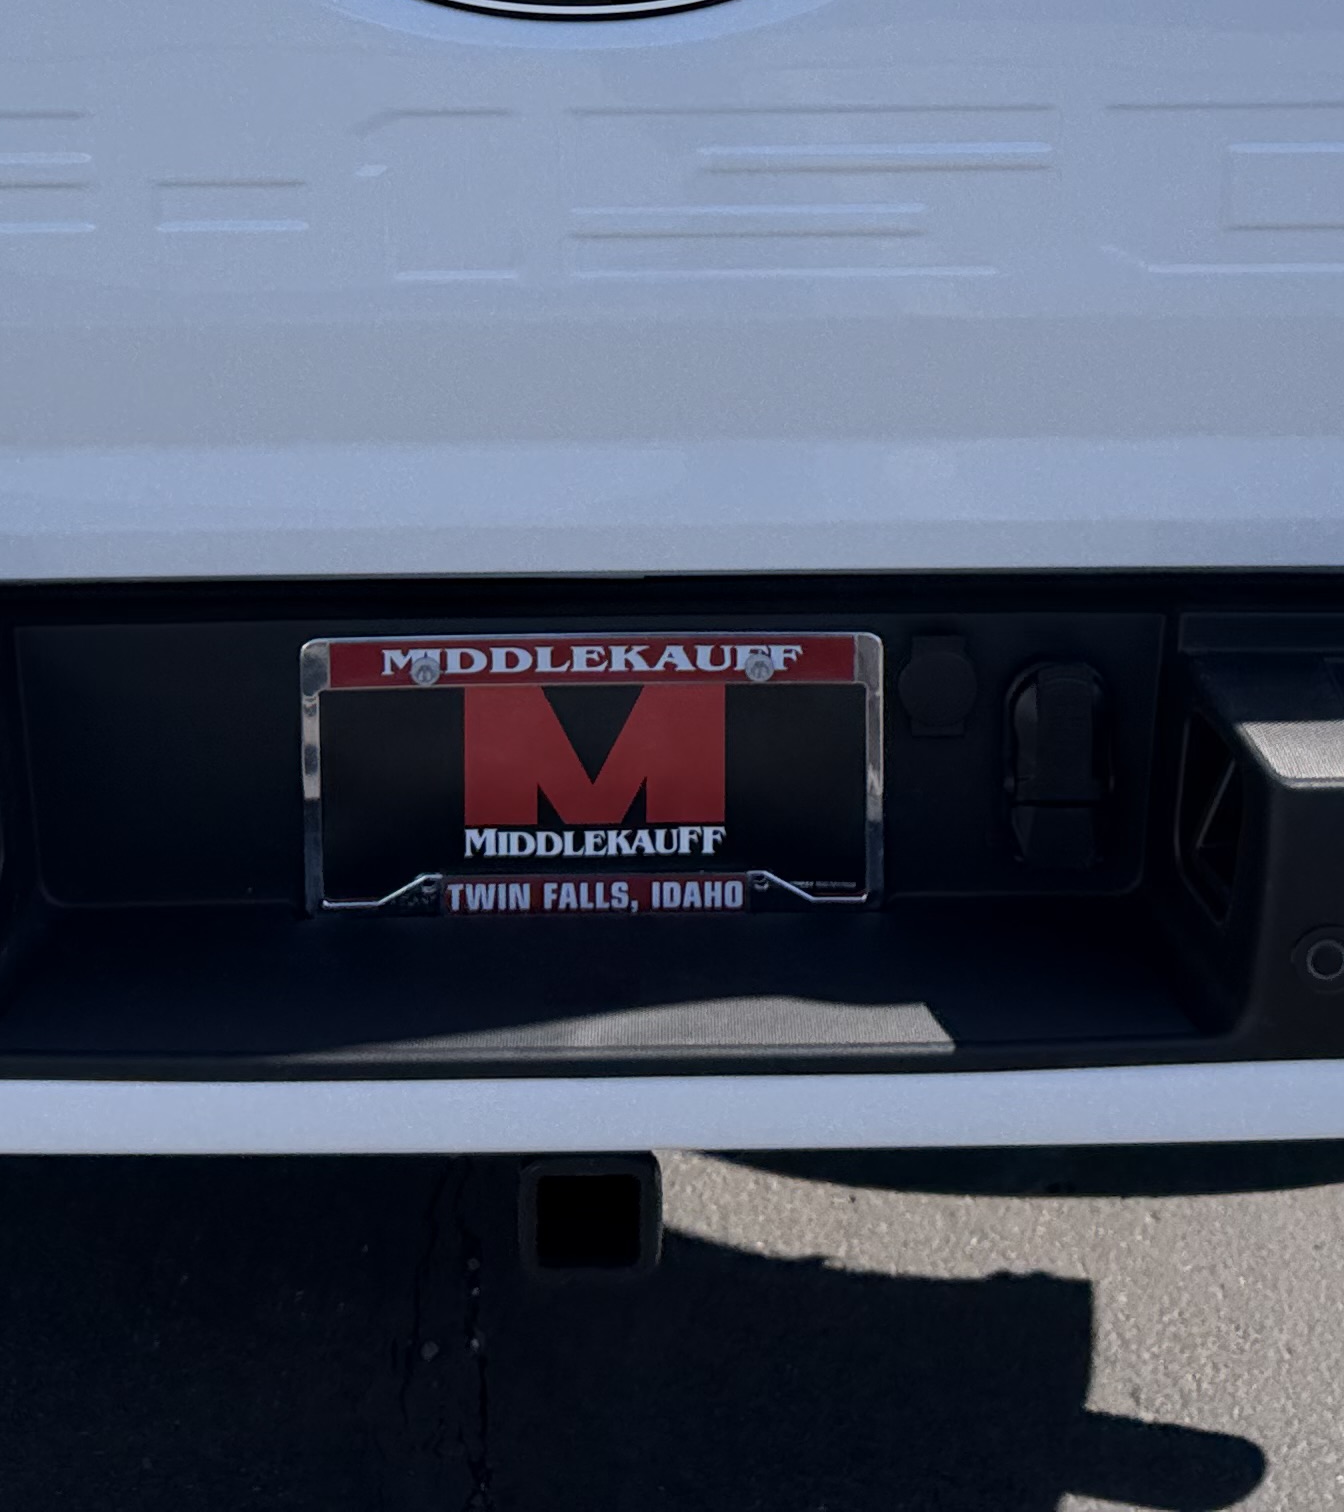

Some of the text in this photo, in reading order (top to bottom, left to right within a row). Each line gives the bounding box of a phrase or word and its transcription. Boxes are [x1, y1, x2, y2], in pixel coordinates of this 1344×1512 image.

[464, 684, 725, 825] M
[464, 825, 726, 858] MIDDLEKAUFF
[447, 880, 744, 914] TWIN FALLS, IDAHO
